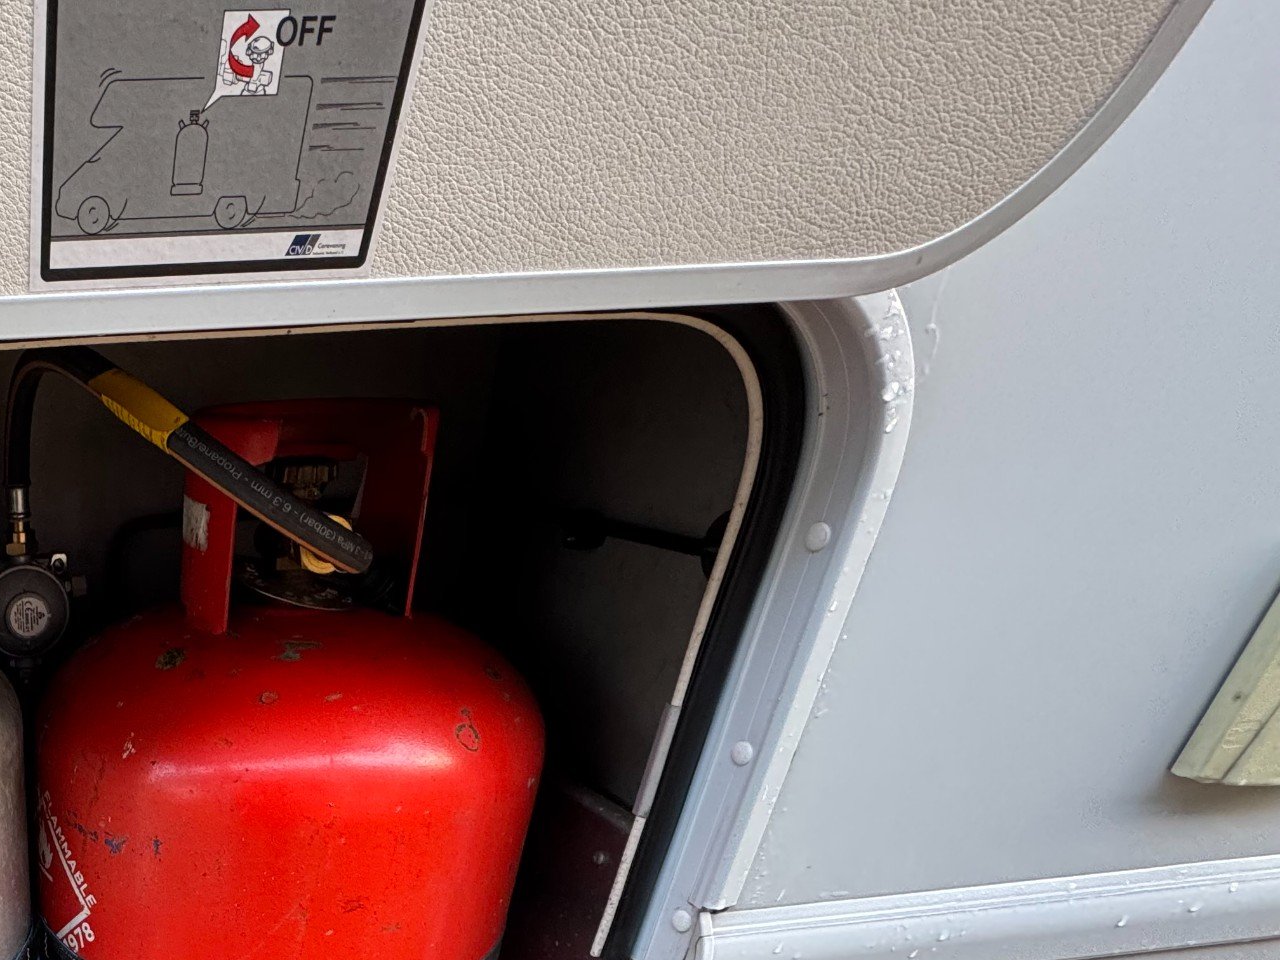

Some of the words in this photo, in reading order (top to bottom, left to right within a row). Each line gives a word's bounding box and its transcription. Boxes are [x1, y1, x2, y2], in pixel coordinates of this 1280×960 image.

[276, 15, 336, 47] OFF
[251, 481, 273, 499] mm
[43, 790, 97, 909] FLAMMABLE
